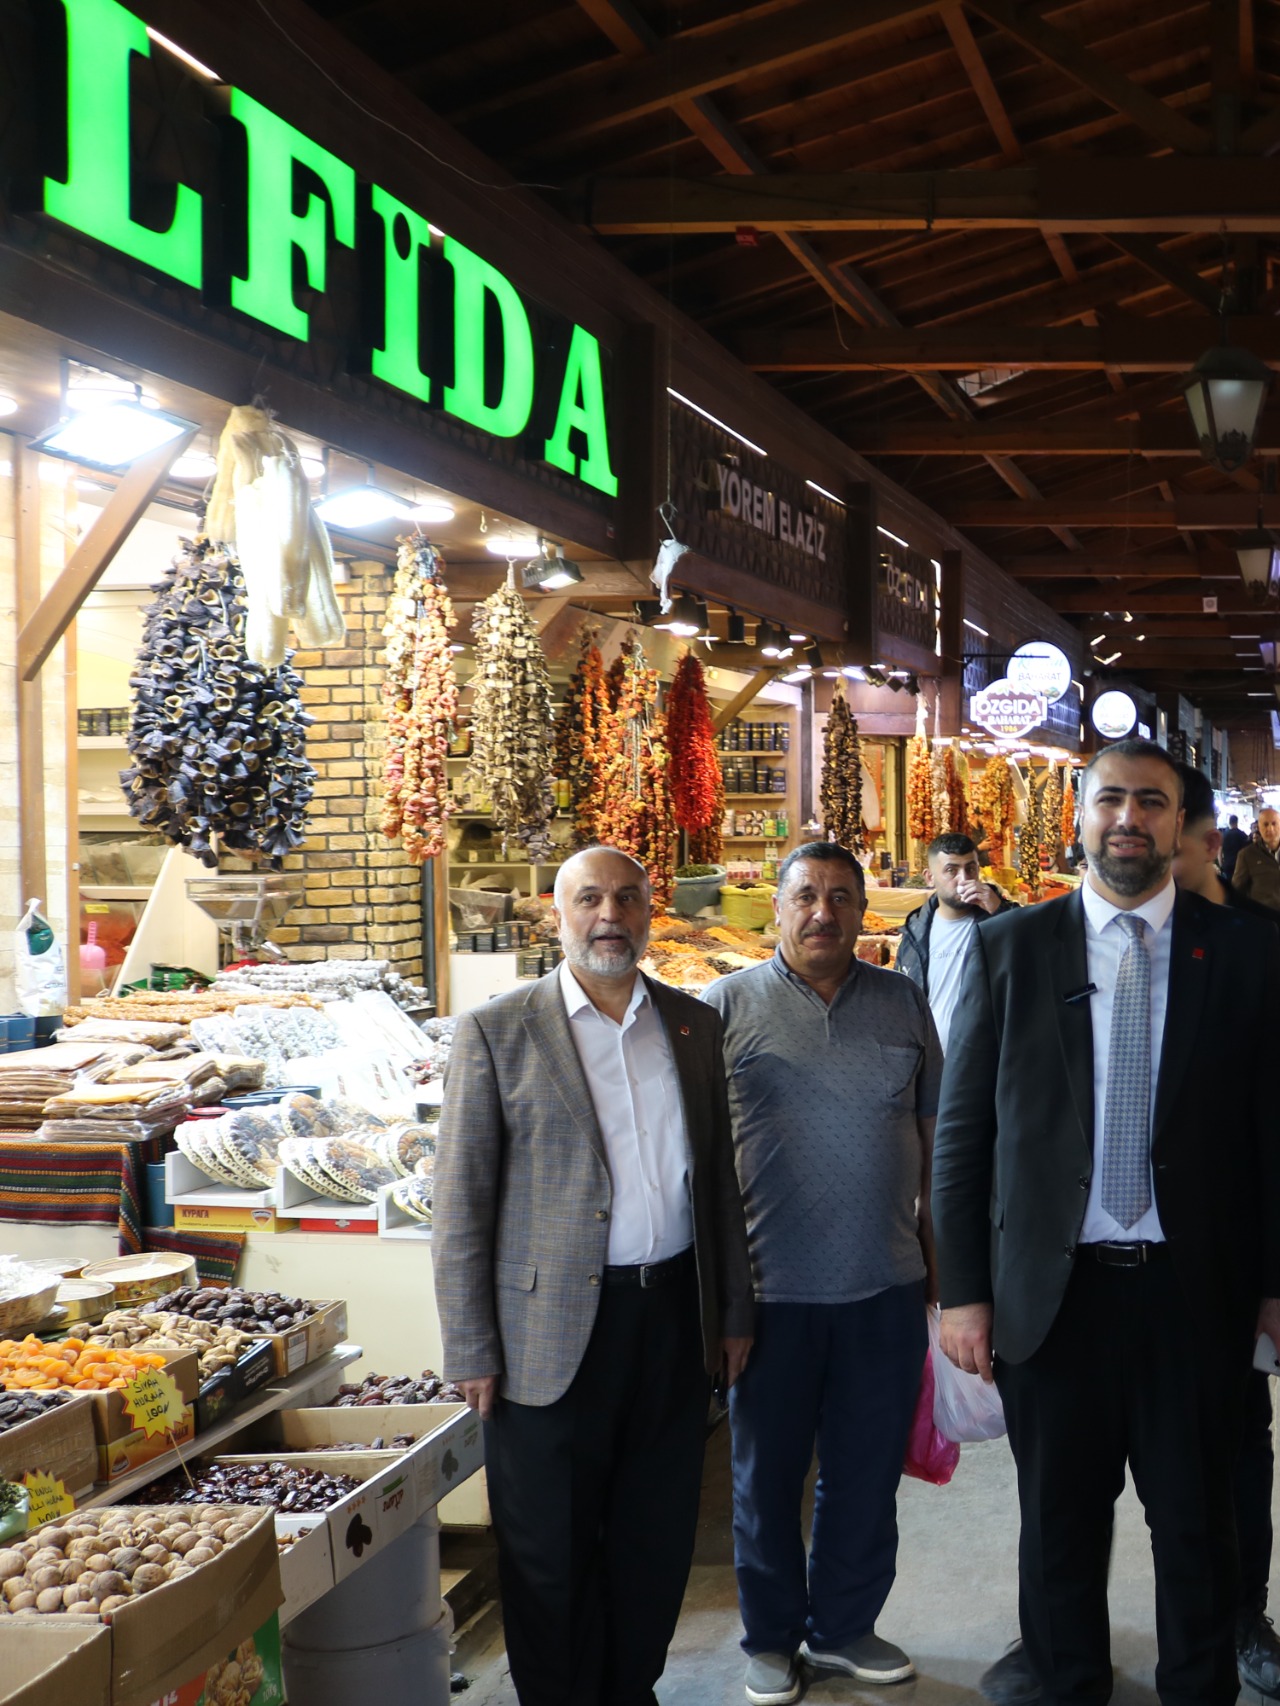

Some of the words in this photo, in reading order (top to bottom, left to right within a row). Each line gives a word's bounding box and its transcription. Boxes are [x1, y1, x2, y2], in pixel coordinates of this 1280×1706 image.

[717, 455, 776, 537] YÖREM
[987, 715, 1032, 725] BAHARAT
[181, 1208, 209, 1220] КУРАГА
